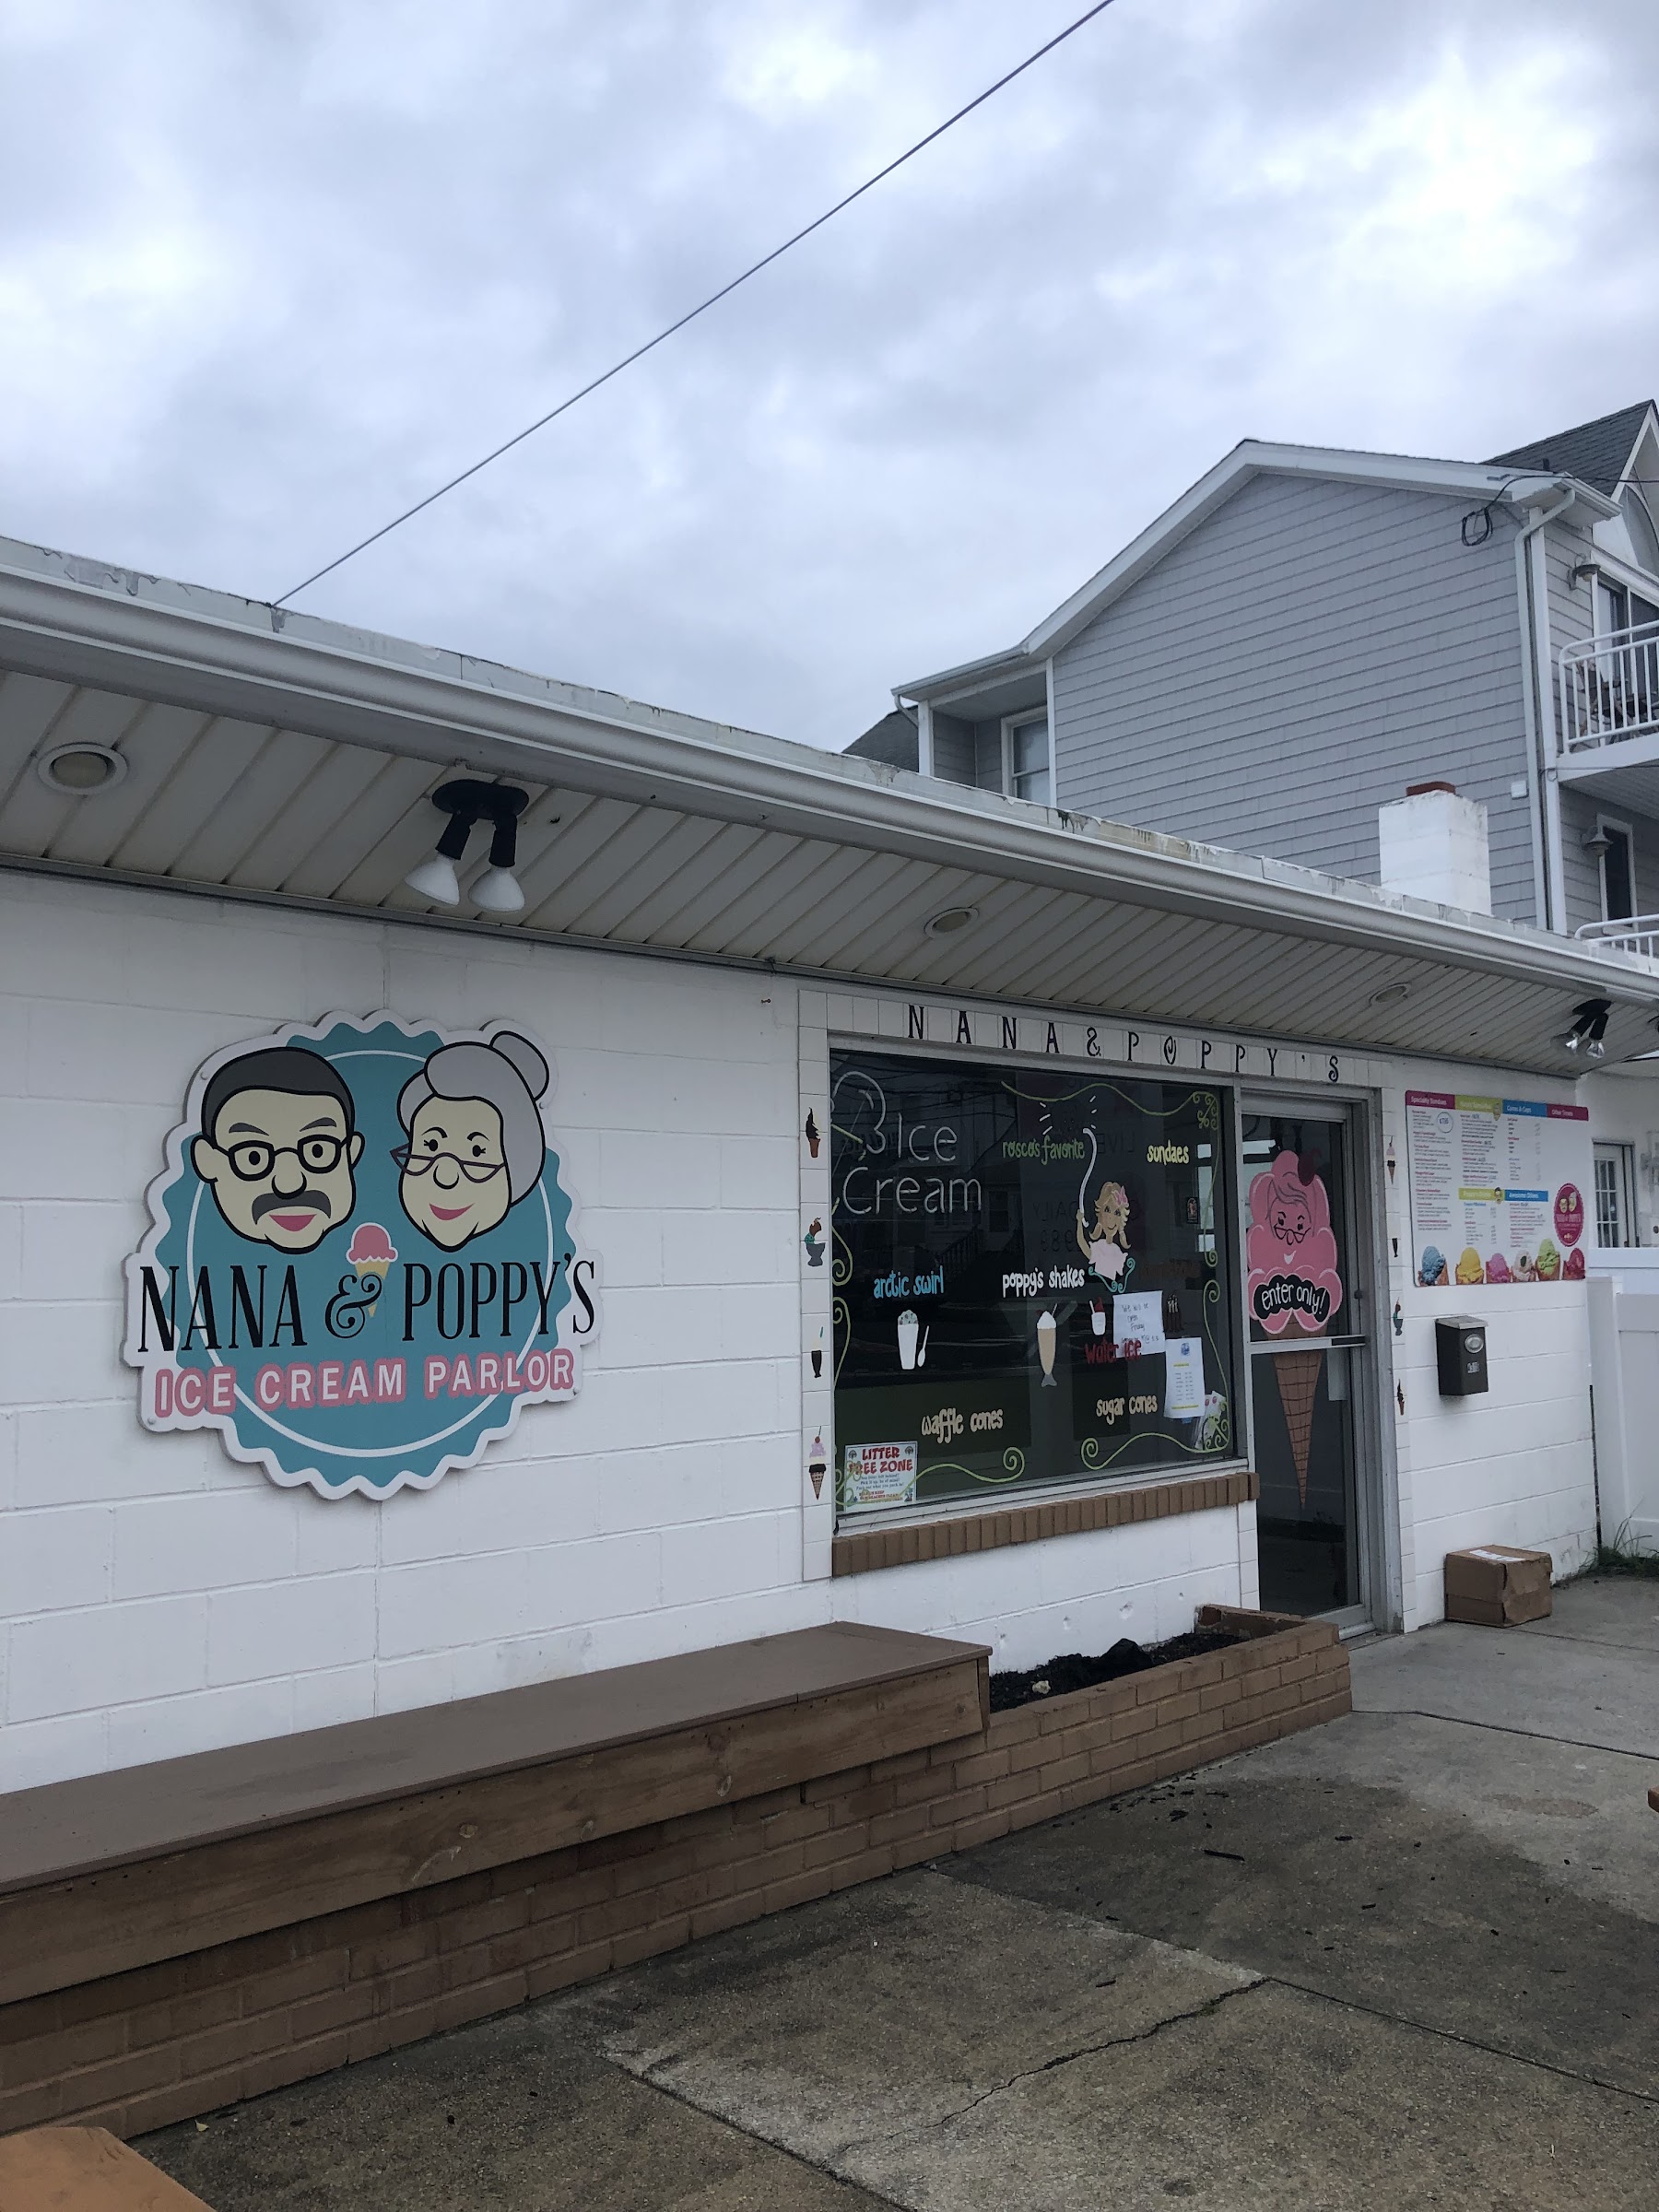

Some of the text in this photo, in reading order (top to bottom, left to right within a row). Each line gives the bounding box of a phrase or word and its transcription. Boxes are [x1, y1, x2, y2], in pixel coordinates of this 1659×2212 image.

[898, 1112, 958, 1161] Ice
[1041, 1135, 1085, 1165] favorite
[1147, 1139, 1190, 1166] sundaes
[842, 1166, 982, 1215] Cream
[874, 1265, 945, 1299] arctic swirl
[1003, 1265, 1086, 1298] poppy's shakes
[137, 1253, 595, 1353] NANA & POPPY'S
[1262, 1282, 1327, 1315] enter only!
[1085, 1337, 1142, 1364] water ice
[156, 1349, 574, 1418] ICE CREAM PARLOR
[921, 1406, 1004, 1444] waffle cones
[1096, 1394, 1158, 1425] sugar cones
[862, 1446, 900, 1461] LITTER
[880, 1459, 913, 1473] ZONE
